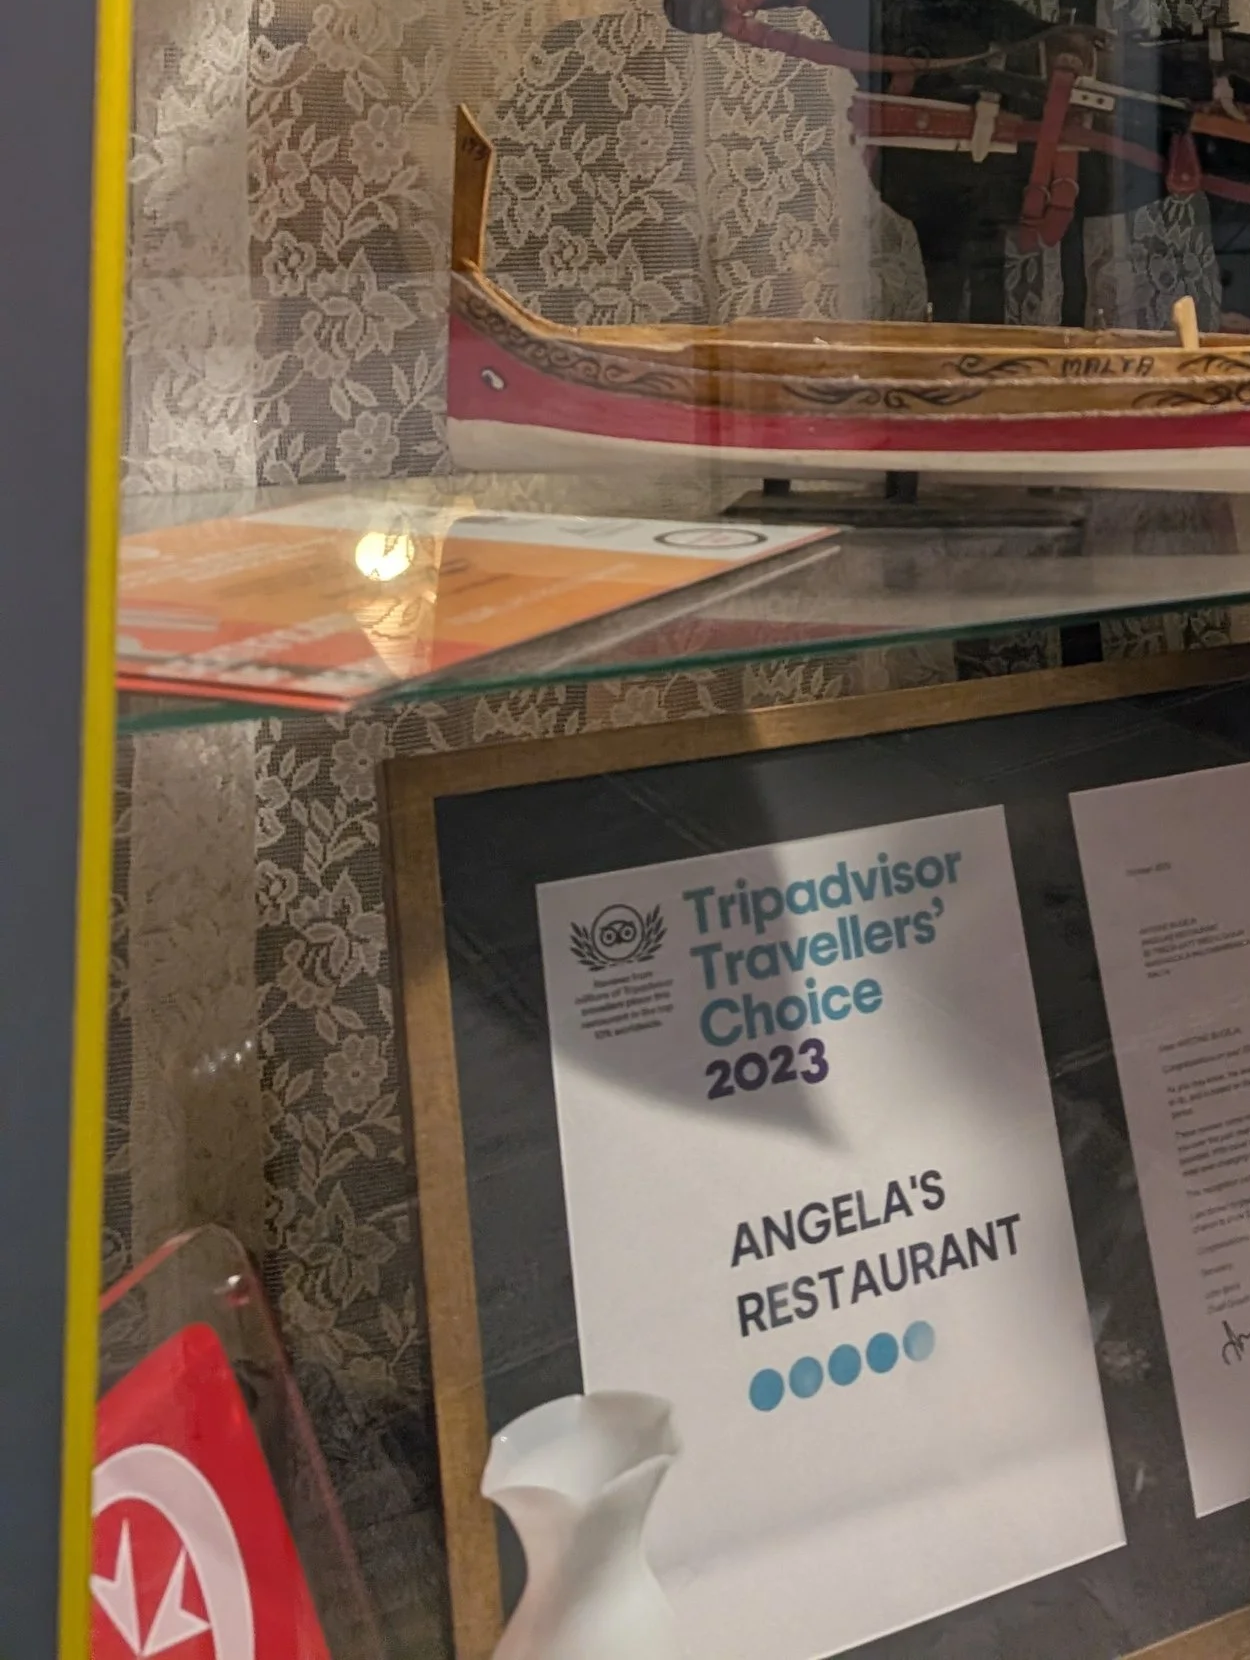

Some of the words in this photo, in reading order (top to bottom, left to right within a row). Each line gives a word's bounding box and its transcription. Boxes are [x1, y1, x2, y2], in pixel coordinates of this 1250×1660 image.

[1062, 356, 1155, 377] MALTA
[682, 851, 961, 935] Tripadvisor
[690, 896, 944, 989] Travellers’
[701, 977, 883, 1046] Choice
[705, 1037, 829, 1099] 2023
[730, 1169, 946, 1268] ANGELA'S
[736, 1213, 1021, 1338] RESTAURANT
